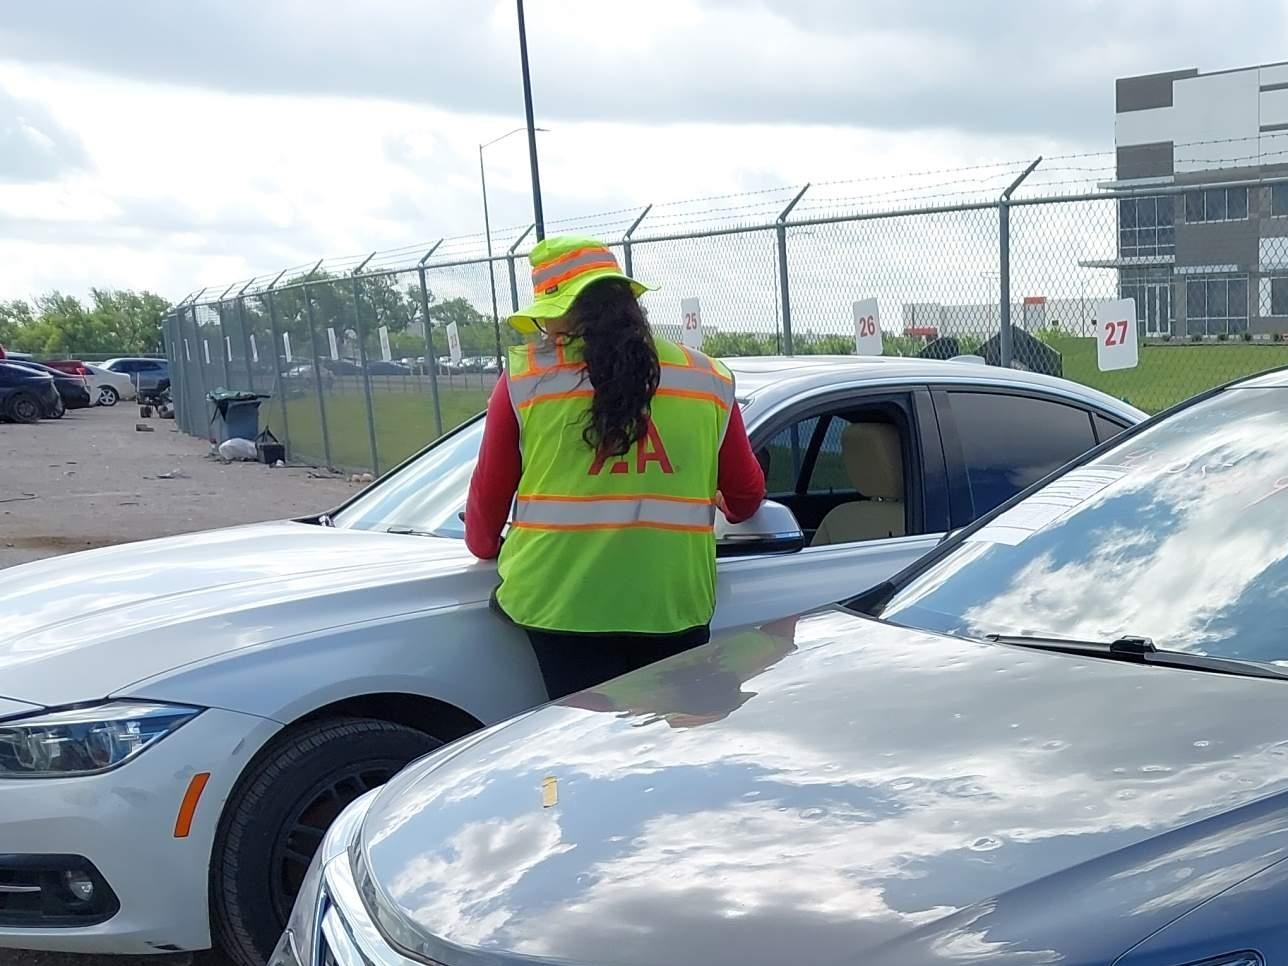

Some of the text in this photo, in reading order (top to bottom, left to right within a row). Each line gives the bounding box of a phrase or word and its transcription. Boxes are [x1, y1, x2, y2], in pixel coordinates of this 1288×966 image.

[685, 311, 698, 330] 25
[859, 315, 875, 337] 26
[1104, 320, 1128, 346] 27
